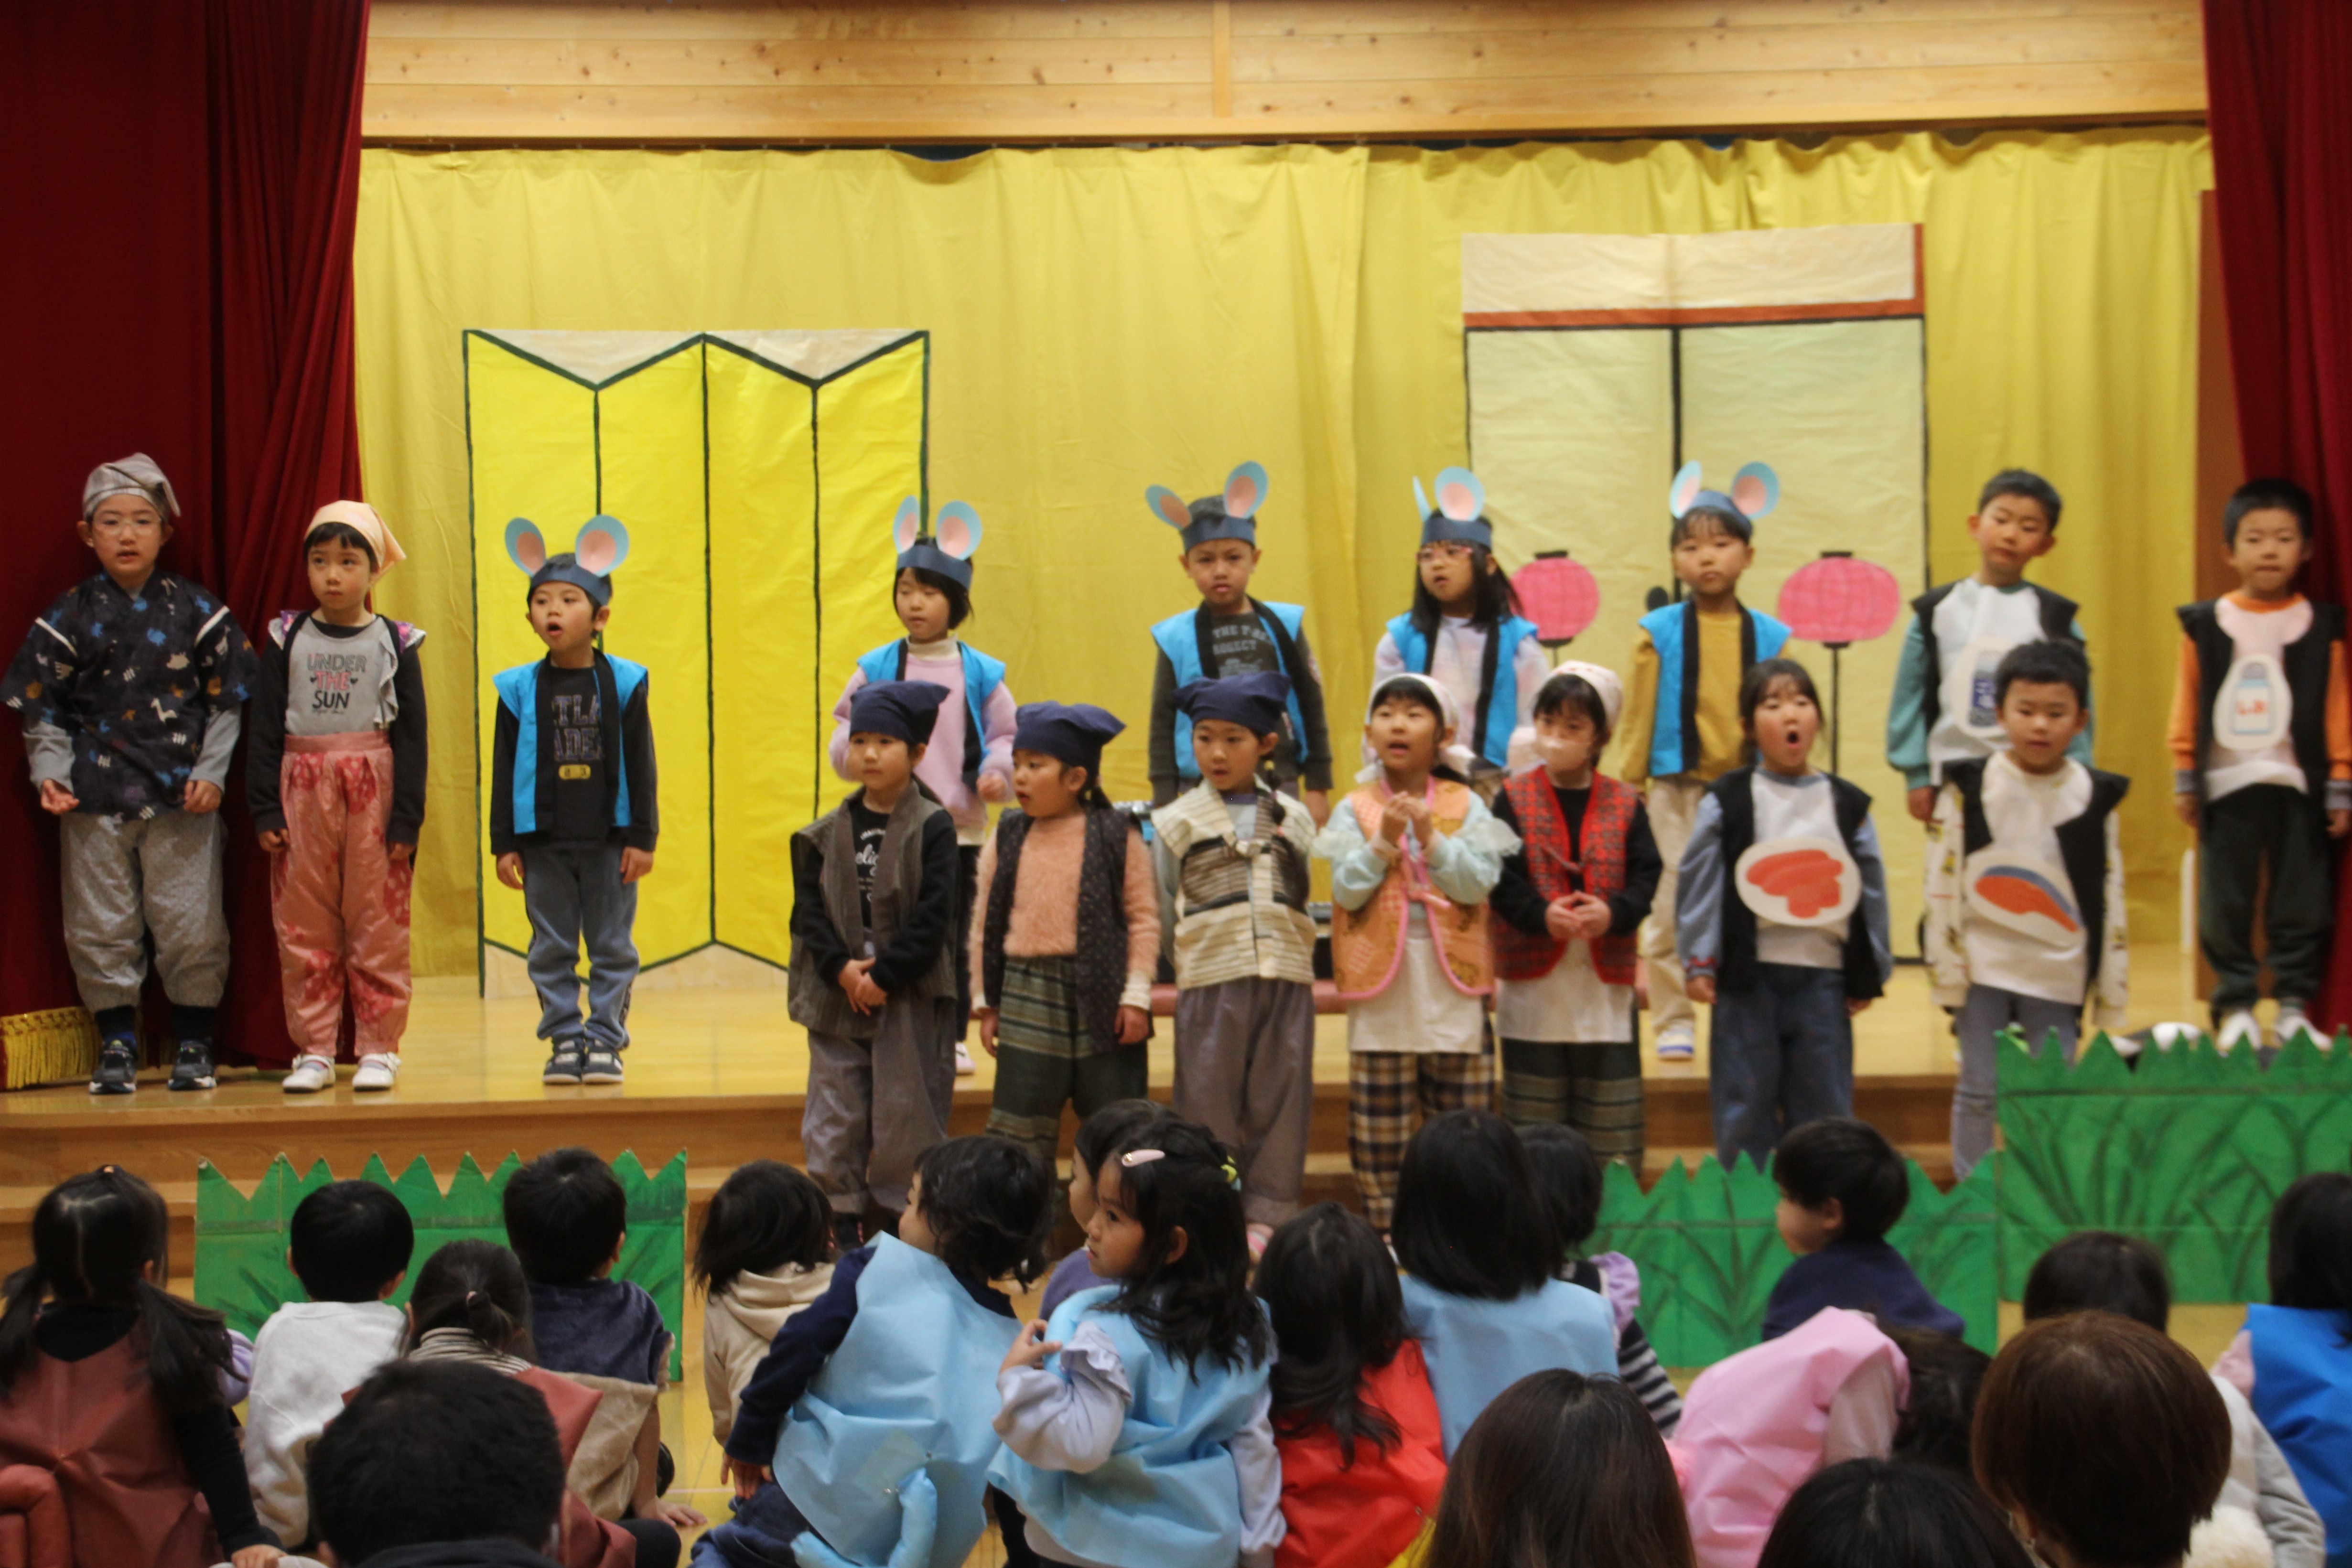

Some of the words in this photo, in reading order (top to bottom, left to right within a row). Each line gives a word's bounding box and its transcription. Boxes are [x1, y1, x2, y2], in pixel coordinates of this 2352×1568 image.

[307, 653, 367, 673] UNDER
[313, 670, 351, 690] THE
[312, 690, 350, 709] SUN
